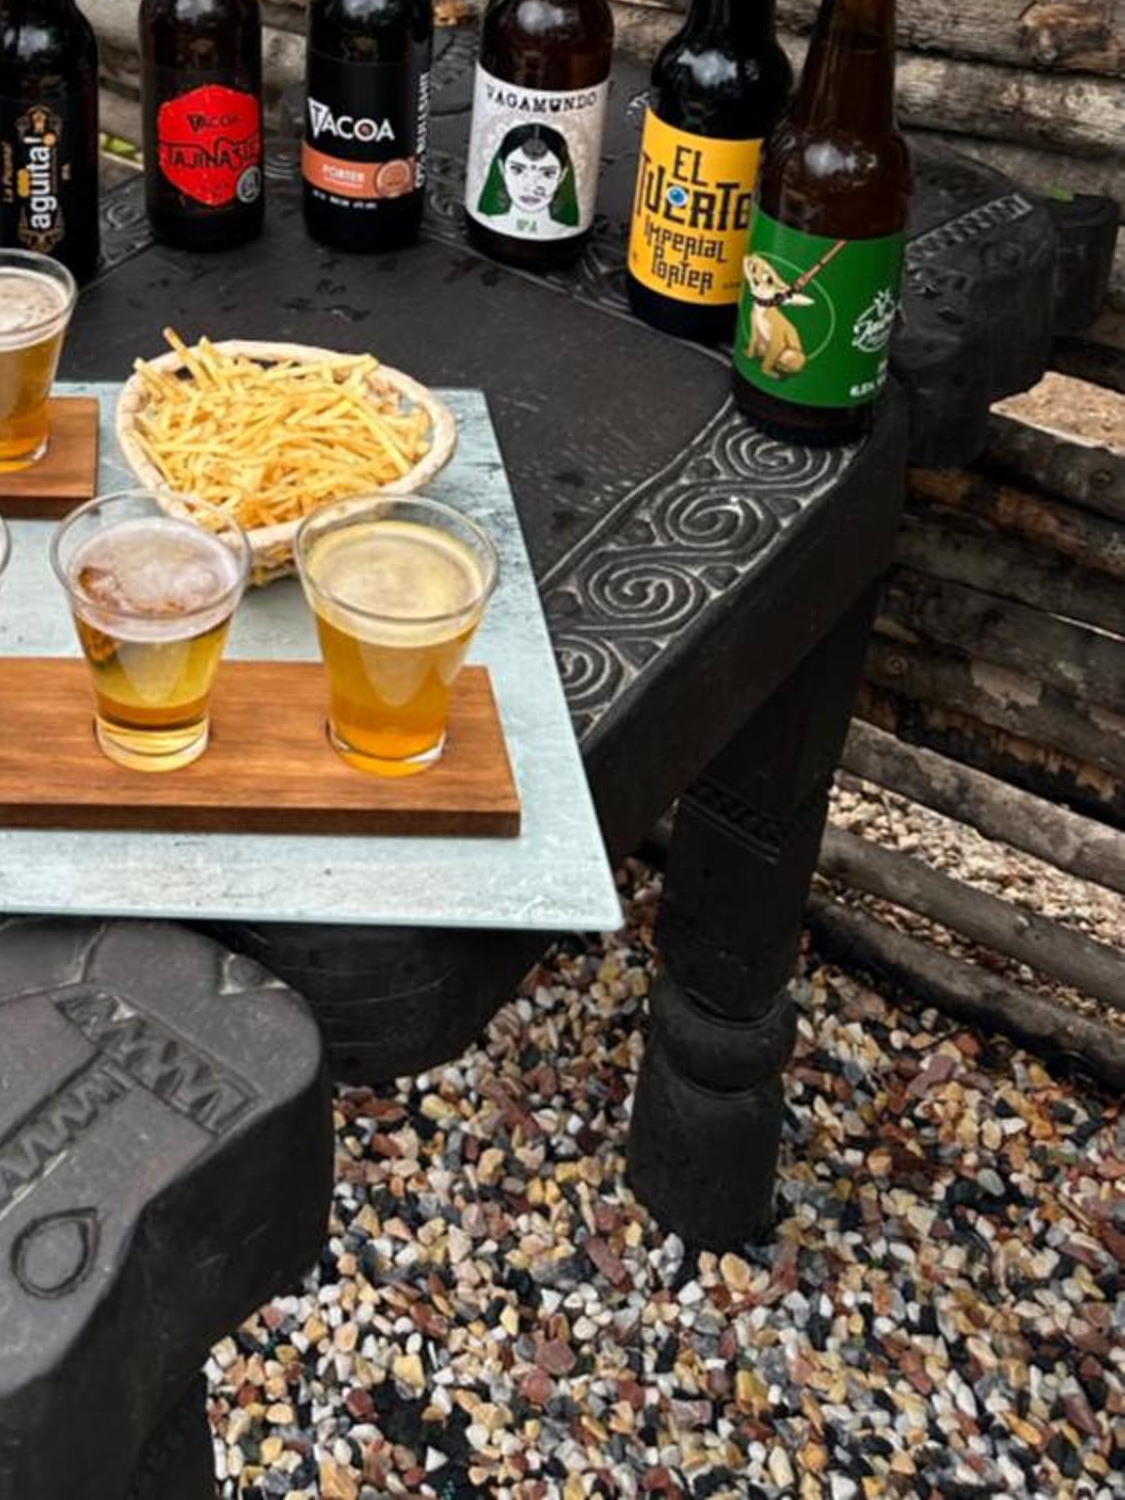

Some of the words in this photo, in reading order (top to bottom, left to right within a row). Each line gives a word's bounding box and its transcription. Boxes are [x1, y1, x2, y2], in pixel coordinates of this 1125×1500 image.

[485, 83, 597, 113] VAGAMUNDO
[307, 97, 395, 142] TACOA
[672, 145, 708, 186] EL
